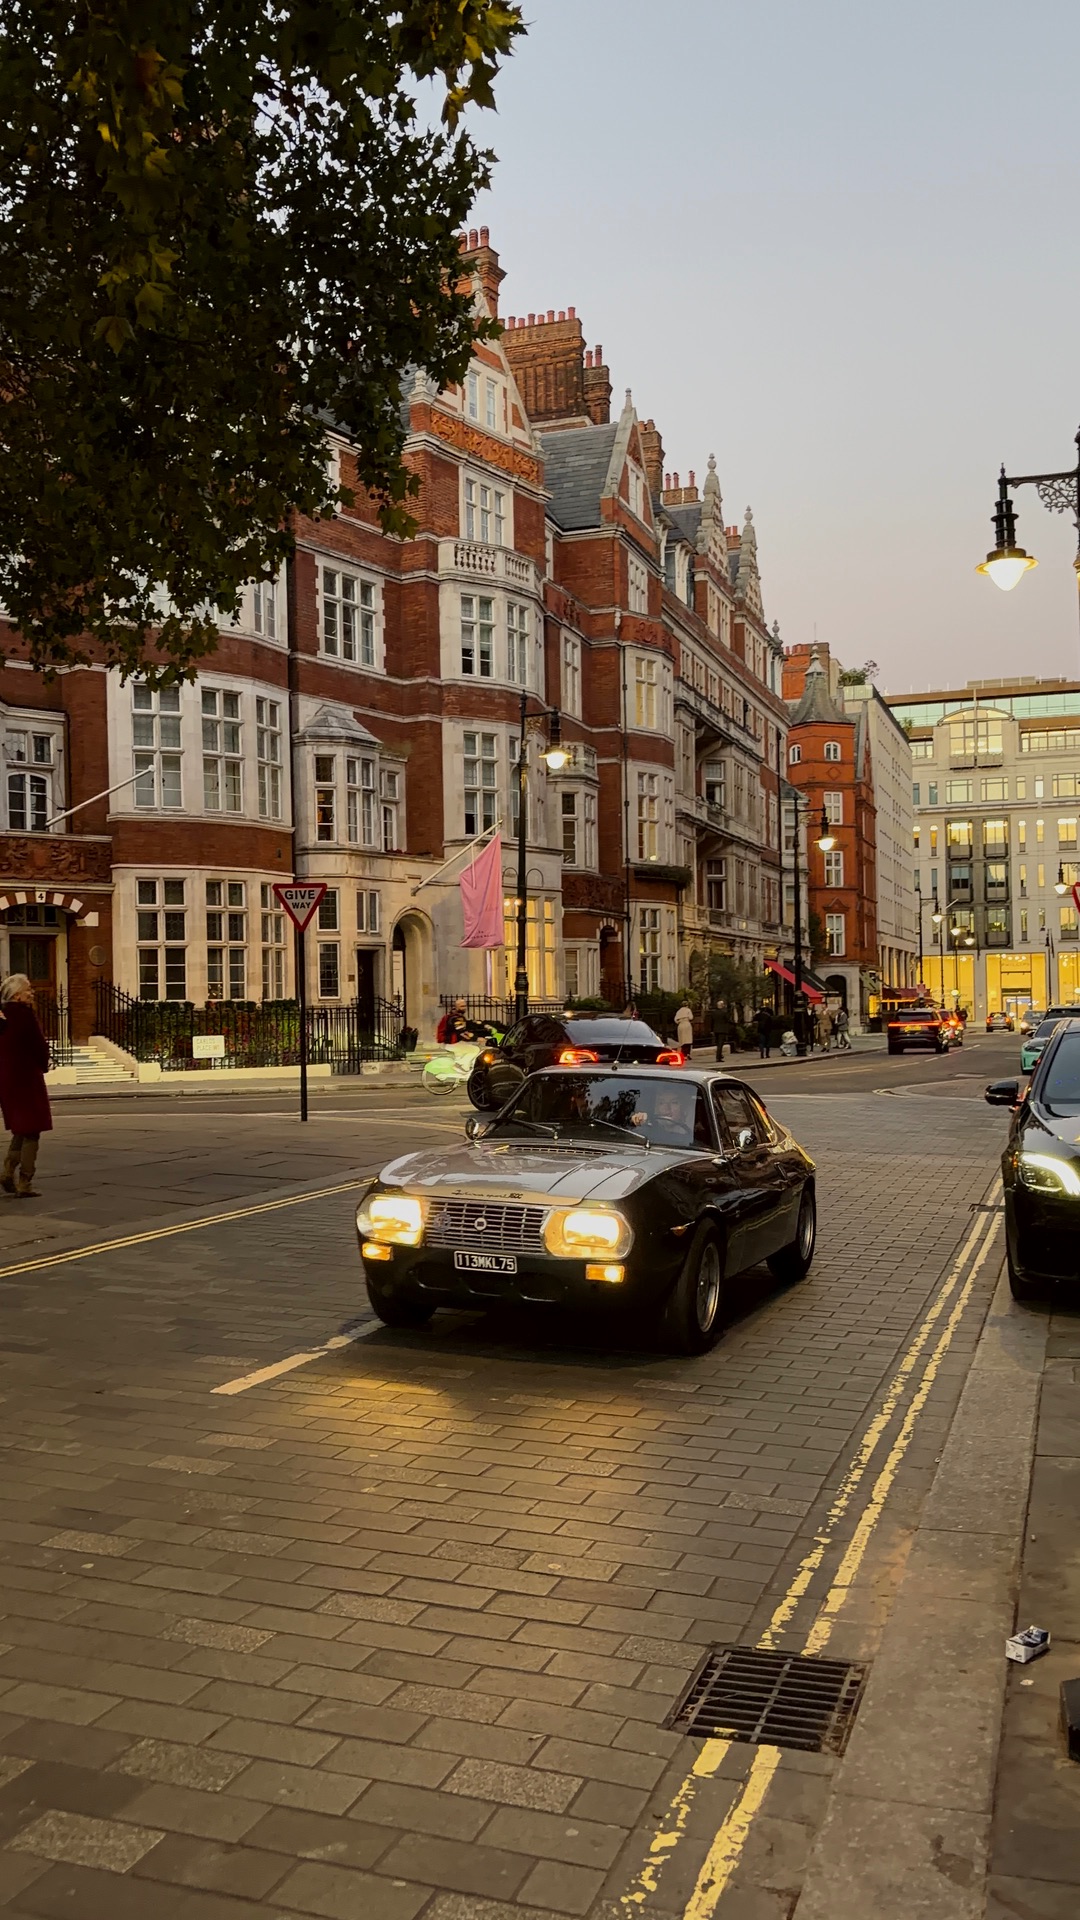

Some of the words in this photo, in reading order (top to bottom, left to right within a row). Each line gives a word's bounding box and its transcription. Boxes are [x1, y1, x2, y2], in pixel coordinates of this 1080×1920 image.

[37, 892, 45, 901] 4
[285, 890, 315, 900] GIVE
[457, 1253, 515, 1271] 113MKL75
